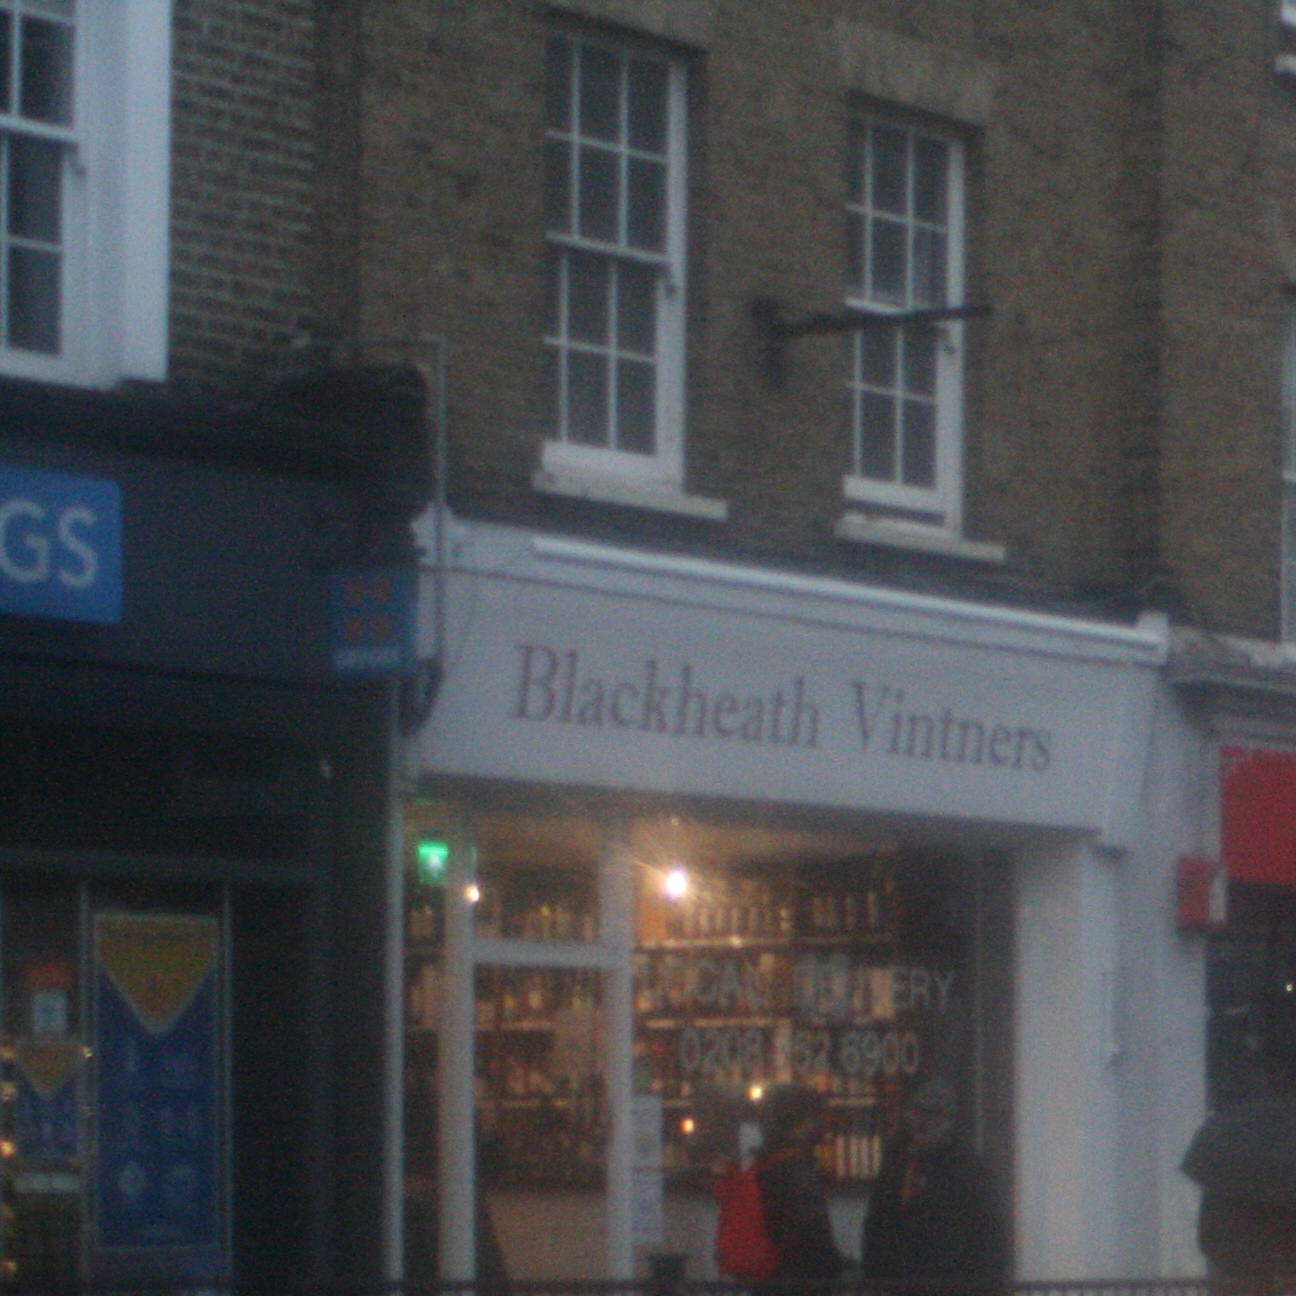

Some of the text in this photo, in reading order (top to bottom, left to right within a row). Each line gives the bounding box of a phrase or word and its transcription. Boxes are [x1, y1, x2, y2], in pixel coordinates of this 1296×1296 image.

[0, 499, 99, 589] GS
[508, 642, 1055, 773] Blackheath Vintners
[842, 1029, 921, 1076] 6900
